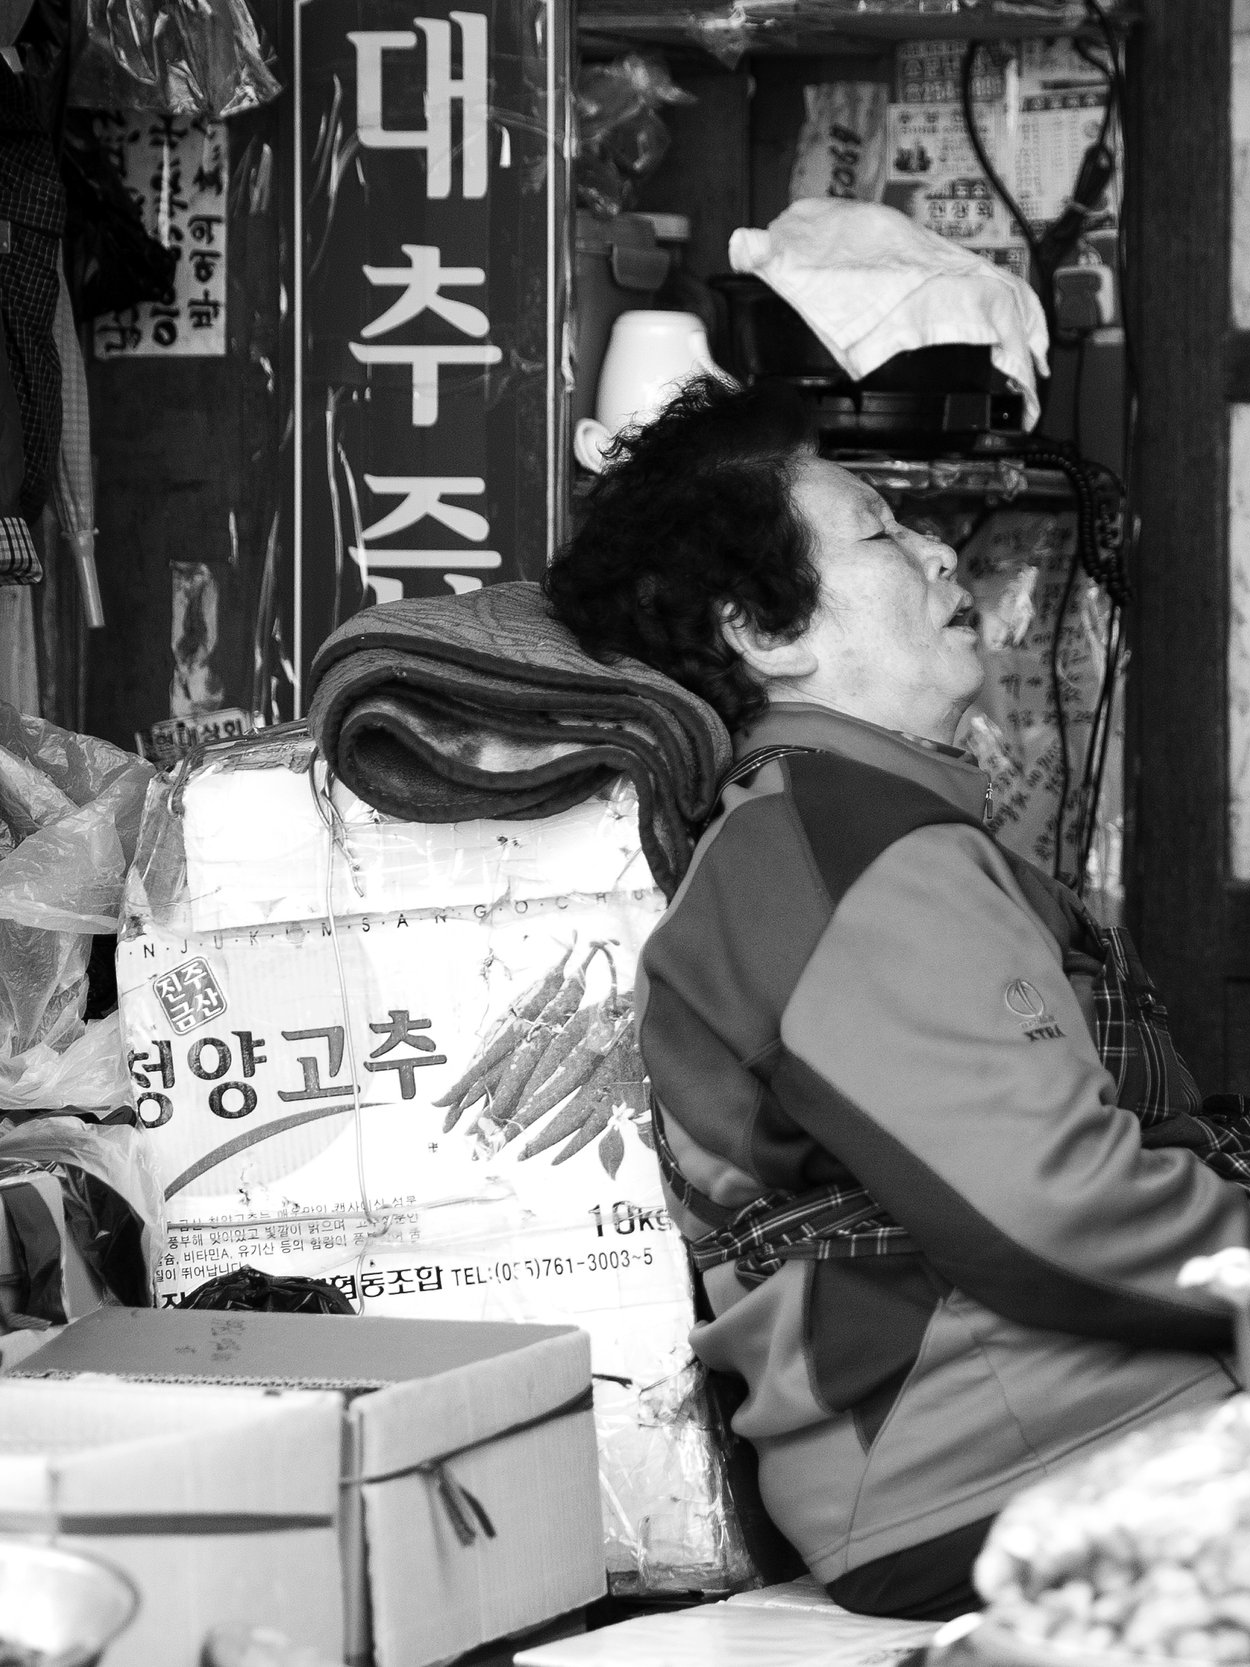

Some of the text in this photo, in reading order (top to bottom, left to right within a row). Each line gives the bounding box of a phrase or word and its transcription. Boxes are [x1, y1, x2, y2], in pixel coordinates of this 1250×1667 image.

[157, 961, 207, 1003] 진주
[170, 988, 222, 1031] 금산
[238, 1242, 275, 1257] 유기산
[280, 1238, 304, 1254] 등의
